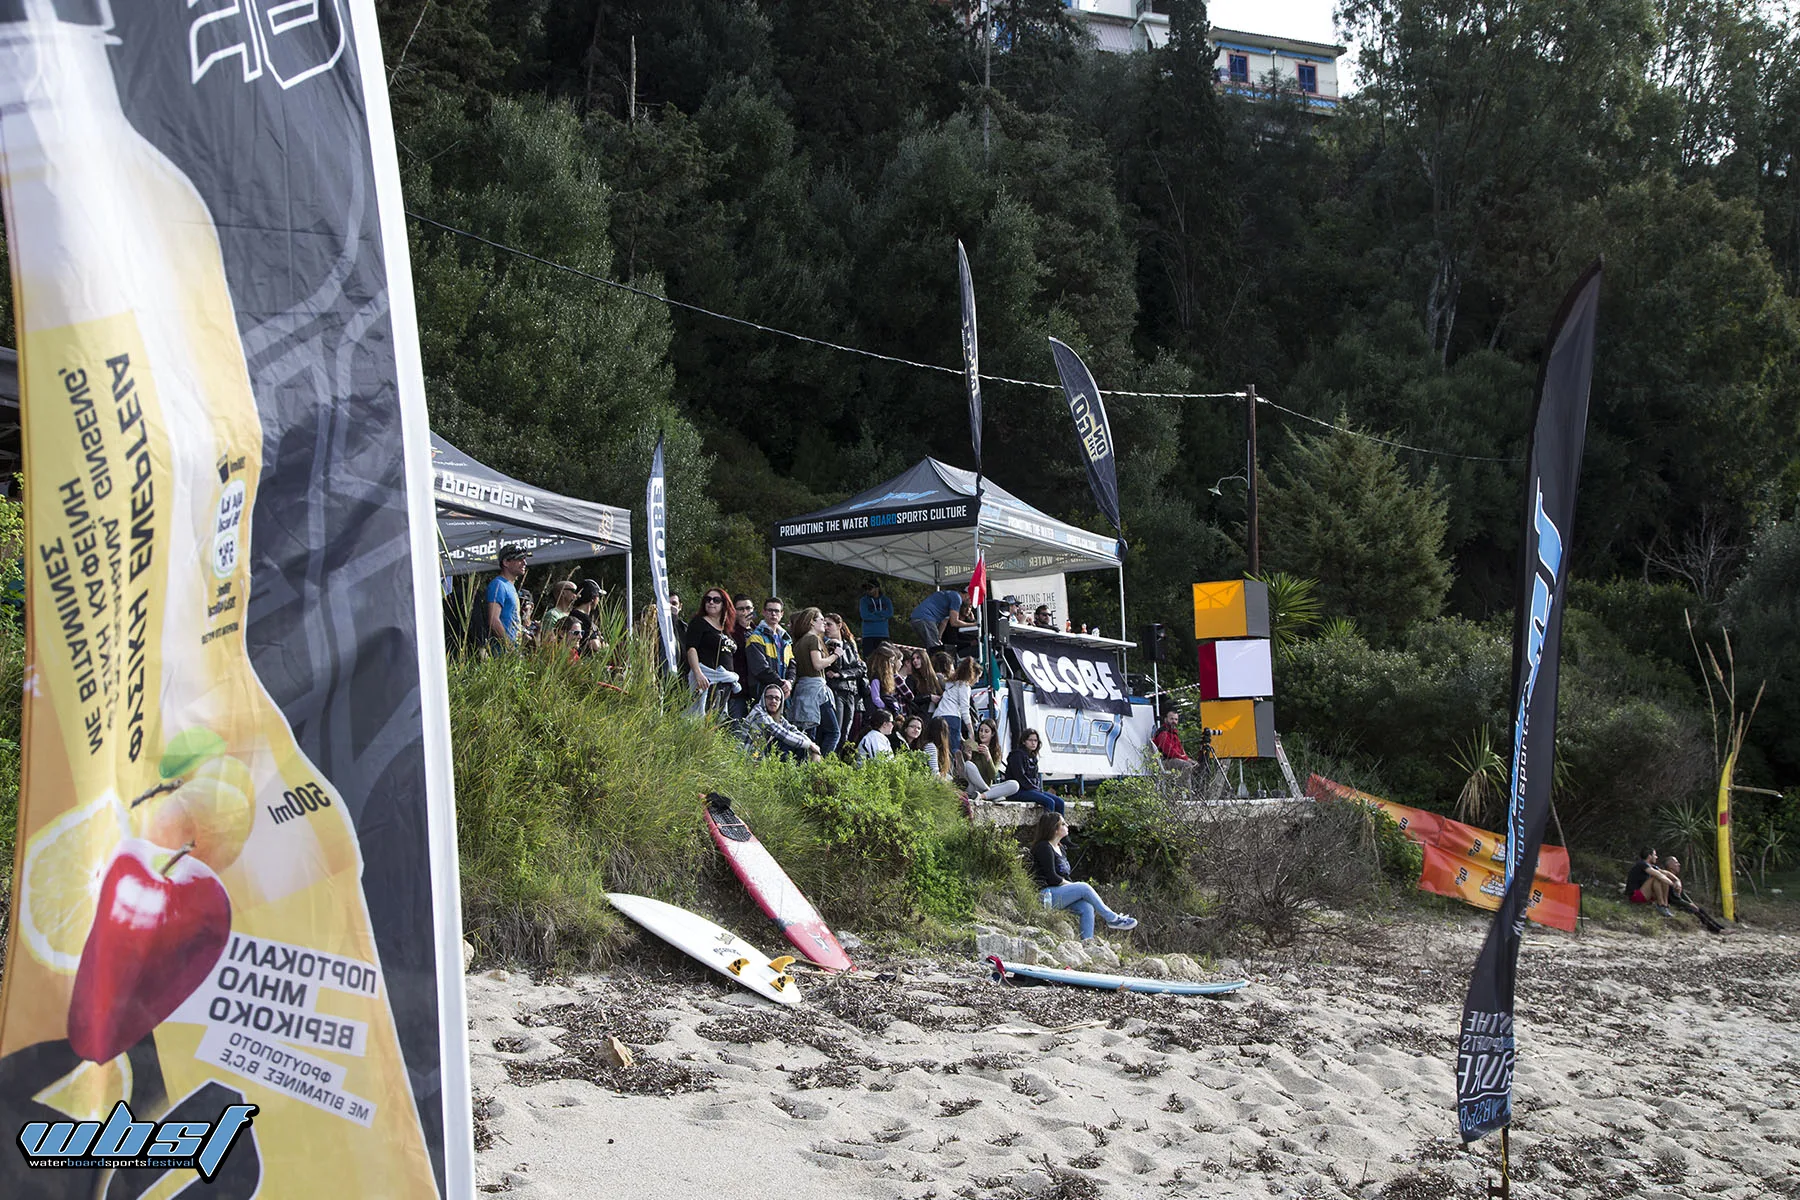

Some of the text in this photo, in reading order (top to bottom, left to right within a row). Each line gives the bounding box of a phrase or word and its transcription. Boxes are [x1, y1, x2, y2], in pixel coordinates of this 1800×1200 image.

[441, 470, 535, 513] Boarders
[780, 521, 824, 537] PROMOTING
[826, 519, 840, 532] THE
[842, 516, 869, 531] WATER
[930, 505, 967, 520] CULTURE
[1021, 650, 1123, 701] GLOBE
[1532, 889, 1542, 904] GO
